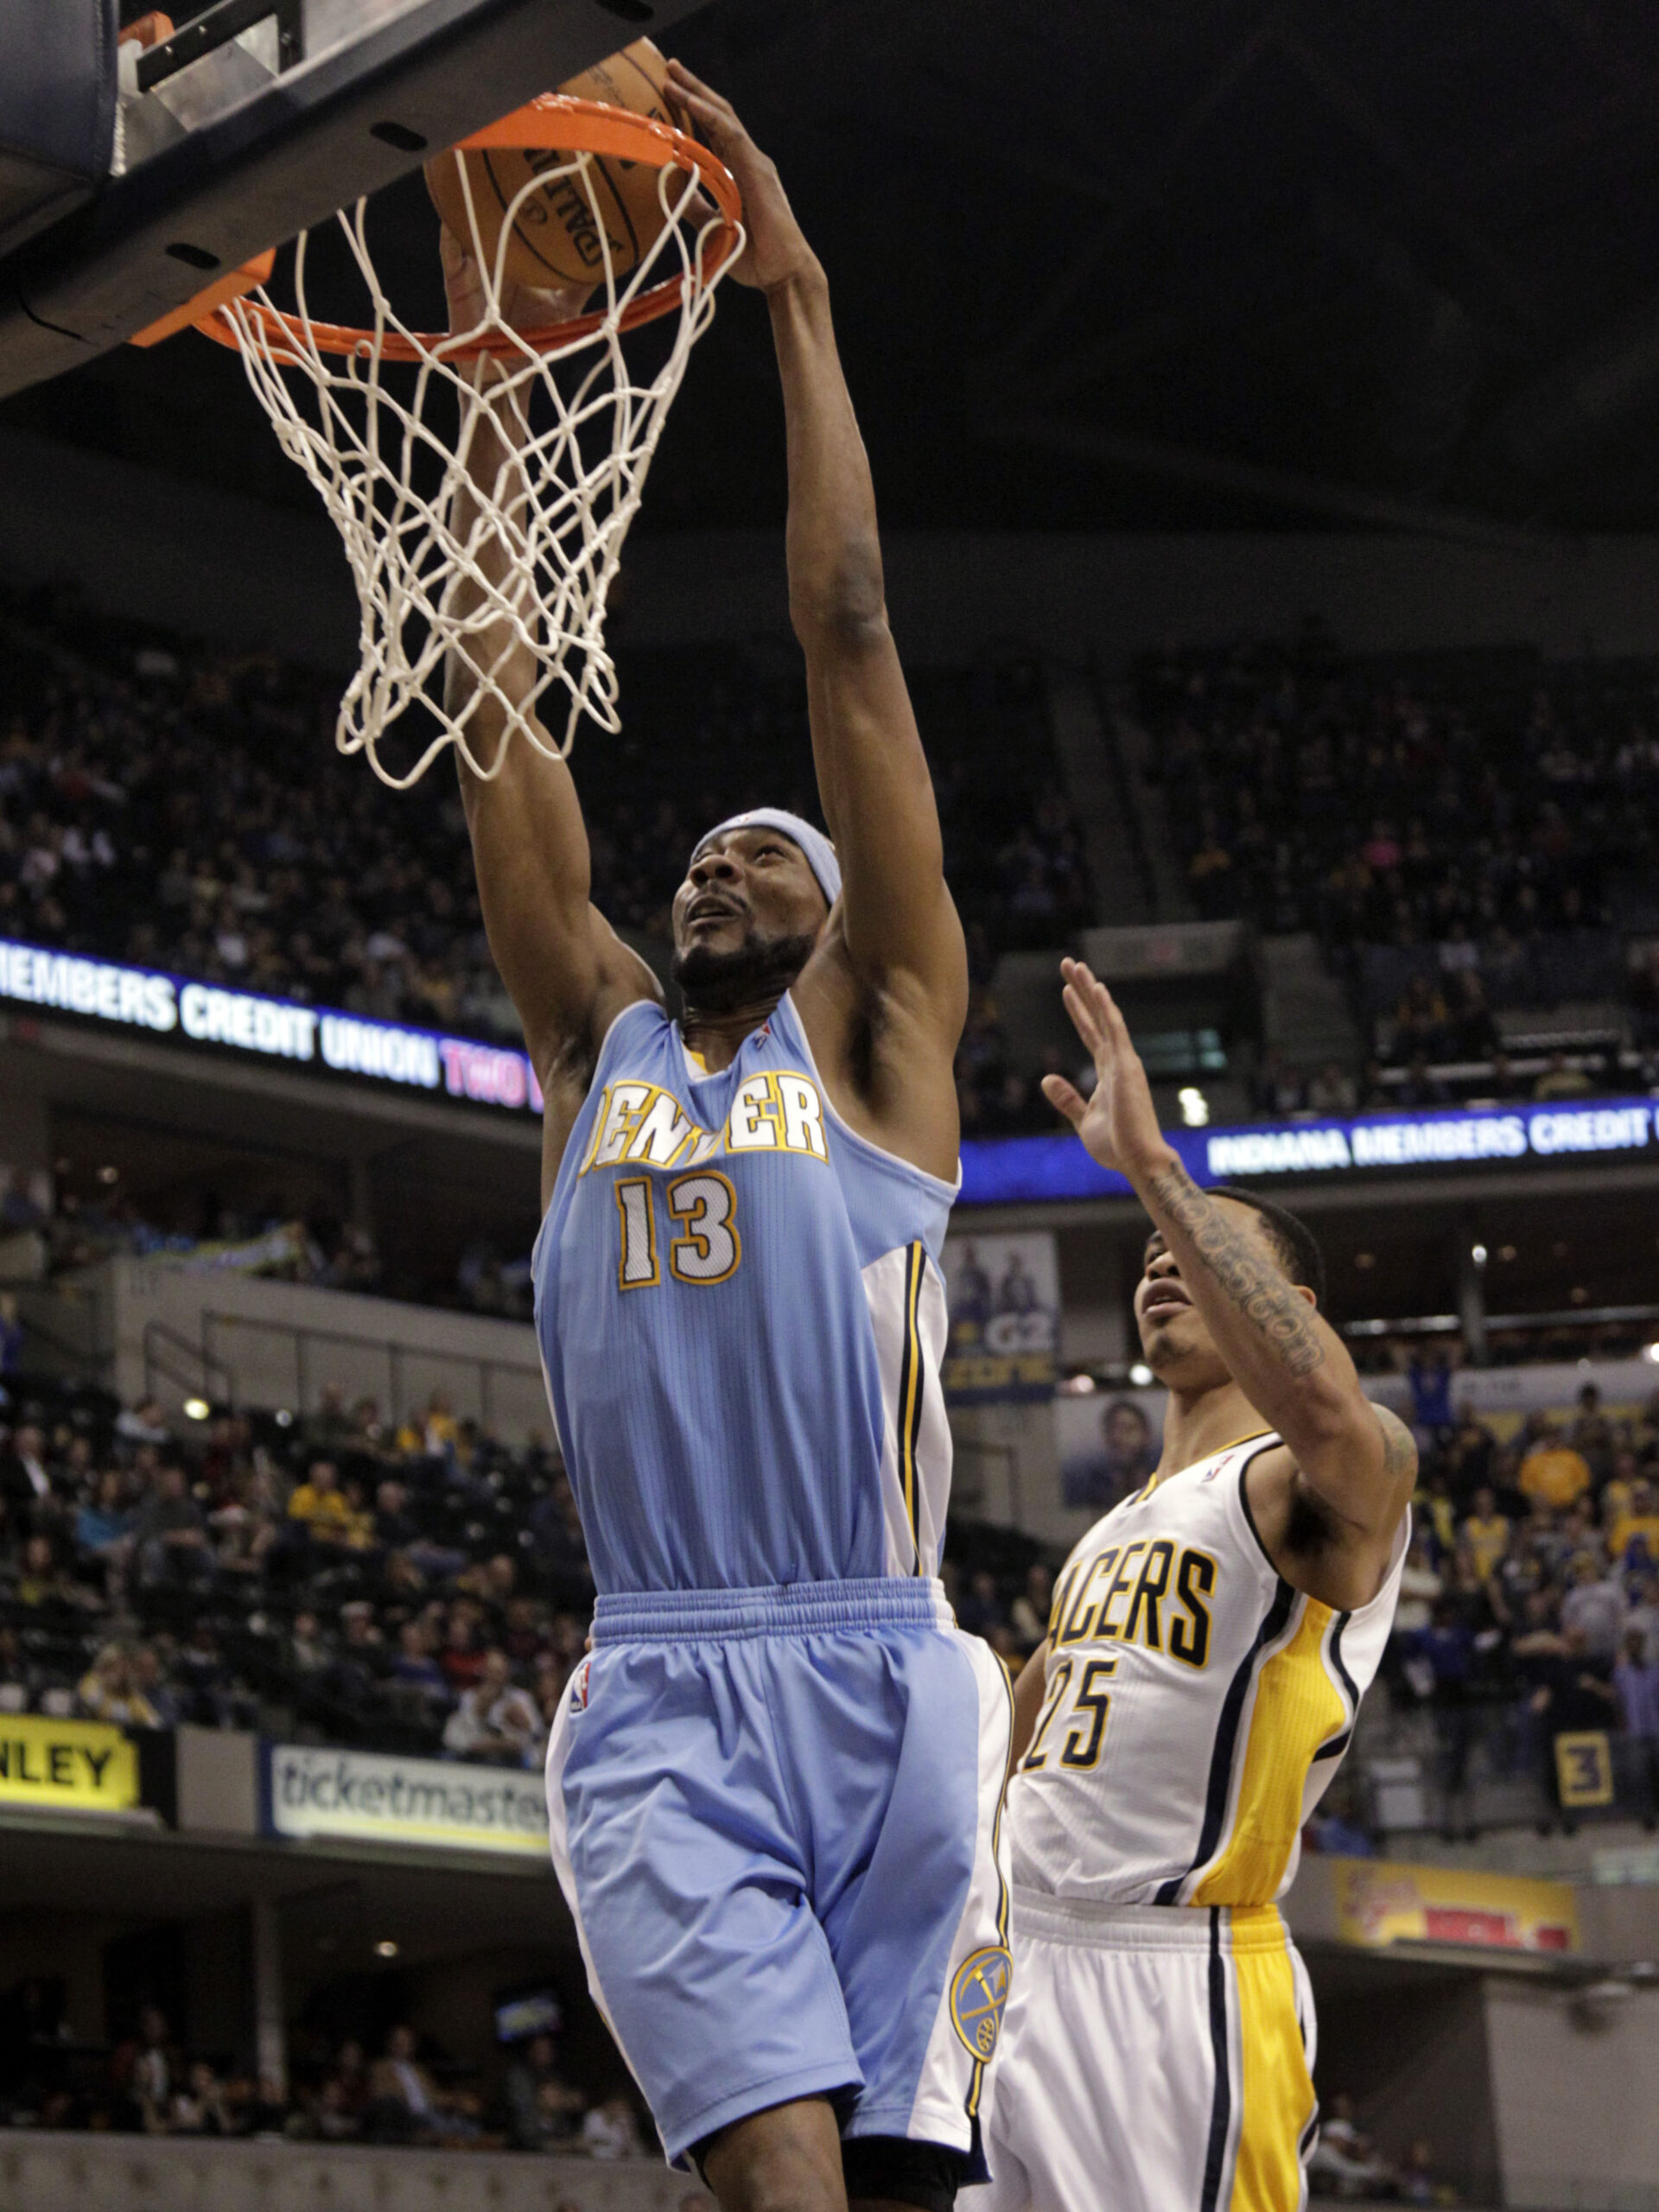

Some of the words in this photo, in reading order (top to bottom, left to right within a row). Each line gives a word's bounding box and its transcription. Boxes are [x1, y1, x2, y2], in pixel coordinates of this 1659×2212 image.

[0, 941, 178, 1032] EMBERS
[180, 982, 318, 1061] CREDIT
[321, 1016, 439, 1089] UNION
[1208, 1129, 1351, 1177] INDIANA
[1351, 1116, 1528, 1166] MEMBERS
[1529, 1107, 1650, 1155] CREDIT
[614, 1169, 741, 1290] 13
[1021, 1658, 1118, 1773] 25
